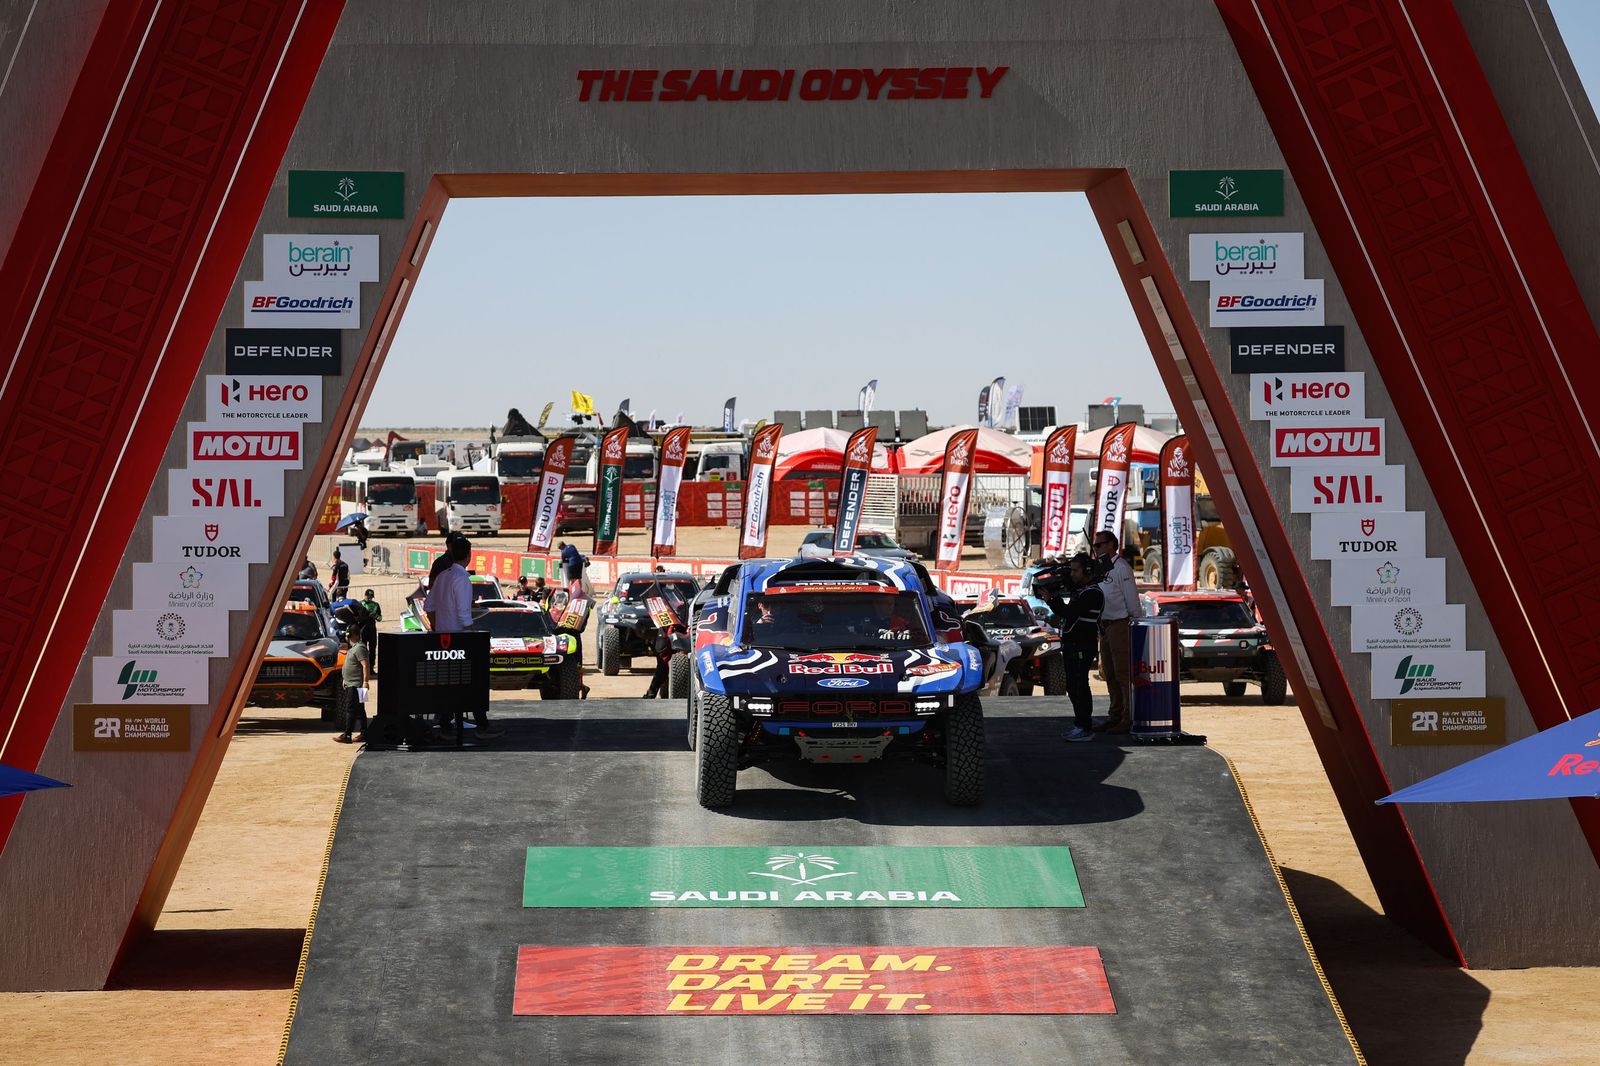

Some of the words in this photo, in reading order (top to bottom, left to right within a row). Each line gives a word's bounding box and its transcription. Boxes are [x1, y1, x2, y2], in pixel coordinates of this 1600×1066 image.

[576, 69, 659, 102] THE
[659, 69, 796, 102] SAUDI
[799, 66, 1011, 101] ODYSSEY
[313, 204, 341, 212] SAUDI
[343, 204, 379, 213] ARABIA
[1194, 203, 1222, 212] SAUDI
[1224, 203, 1259, 211] ARABIA
[289, 240, 350, 263] berain
[1215, 239, 1276, 262] berain
[289, 263, 350, 277] بيرين
[1215, 261, 1276, 276] بيرين
[252, 296, 353, 309] BFGoodrich
[1217, 294, 1317, 308] BFGoodrich
[234, 345, 333, 358] DEFENDER
[1238, 343, 1336, 356] DEFENDER
[198, 435, 295, 457] MOTUL
[1280, 431, 1376, 454] MOTUL
[1050, 454, 1070, 465] DAKAR
[1106, 452, 1128, 464] DAKAR
[1167, 467, 1191, 478] DAKAR
[192, 478, 262, 508] SAL
[1313, 475, 1383, 504] SAL
[605, 486, 614, 513] ARABIA
[750, 471, 765, 539] BFGoodrich
[539, 487, 556, 531] TUDOR
[840, 472, 861, 549] DEFENDER
[1104, 490, 1119, 533] UDOR
[604, 513, 613, 536] SAUDI
[1046, 486, 1066, 552] MOTUL
[1169, 515, 1182, 555] berain
[182, 546, 241, 558] TUDOR
[1339, 540, 1398, 553] TUDOR
[168, 601, 190, 609] Ministry
[197, 601, 214, 609] Sport
[424, 650, 466, 661] TUDOR
[266, 666, 295, 677] MINI
[788, 663, 842, 675] Red
[843, 662, 894, 675] Bull
[826, 679, 859, 688] Ford
[778, 700, 911, 714] FORD
[124, 724, 169, 732] RALLY-RAID
[1442, 717, 1486, 725] RALLY-RAID
[1547, 753, 1600, 777] Re
[649, 890, 780, 902] SAUDI
[791, 890, 962, 903] ARABIA
[665, 954, 953, 972] DREAM.
[665, 973, 887, 991] DARE.
[665, 993, 844, 1011] LIVE
[845, 993, 932, 1011] IT.
